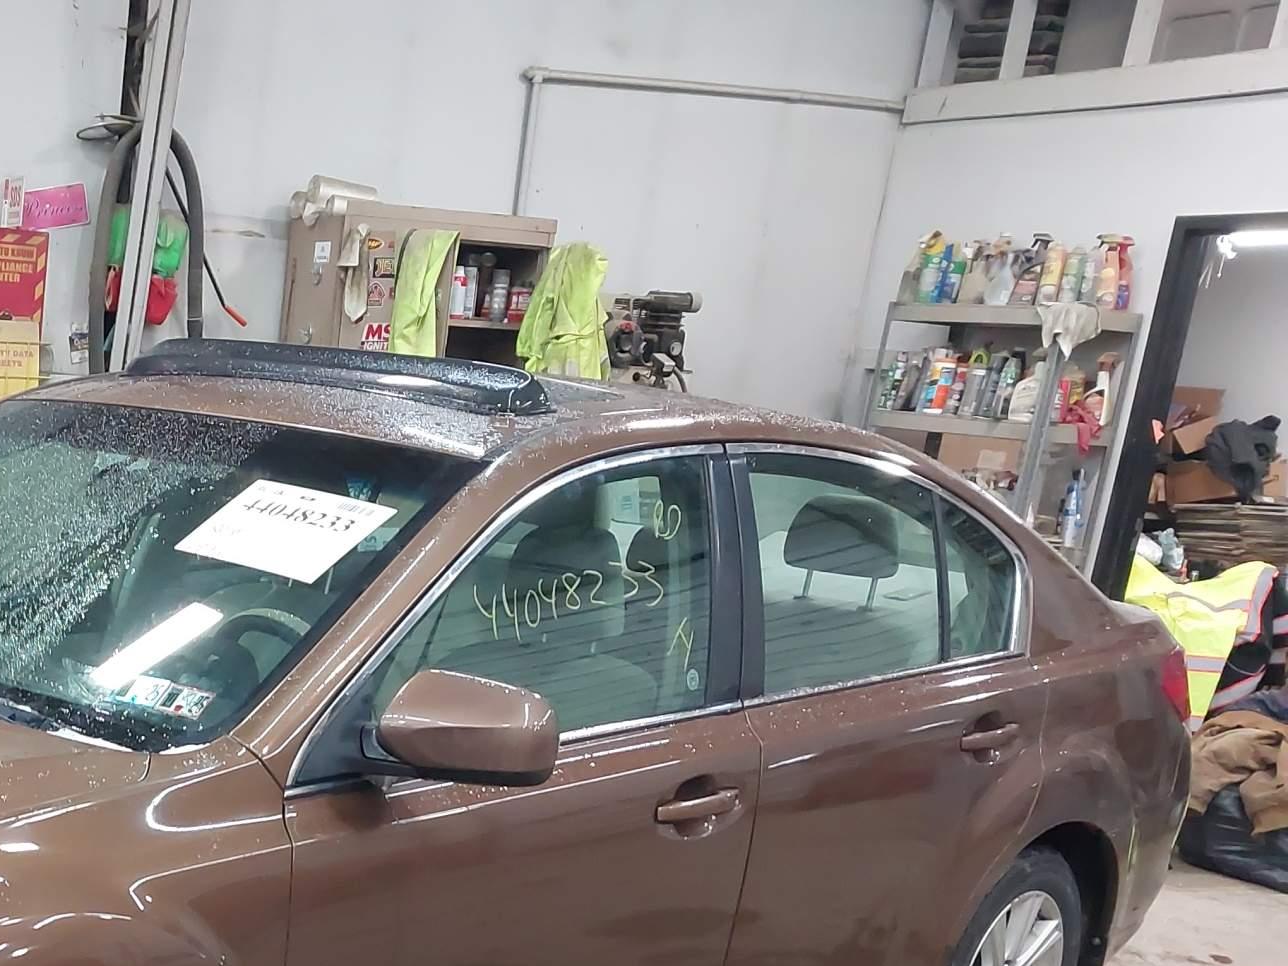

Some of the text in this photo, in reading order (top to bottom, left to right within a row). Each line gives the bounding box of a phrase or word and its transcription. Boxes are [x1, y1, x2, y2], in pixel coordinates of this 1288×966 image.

[13, 350, 34, 358] DATA
[242, 498, 356, 532] 44048233
[472, 559, 665, 642] 44048233
